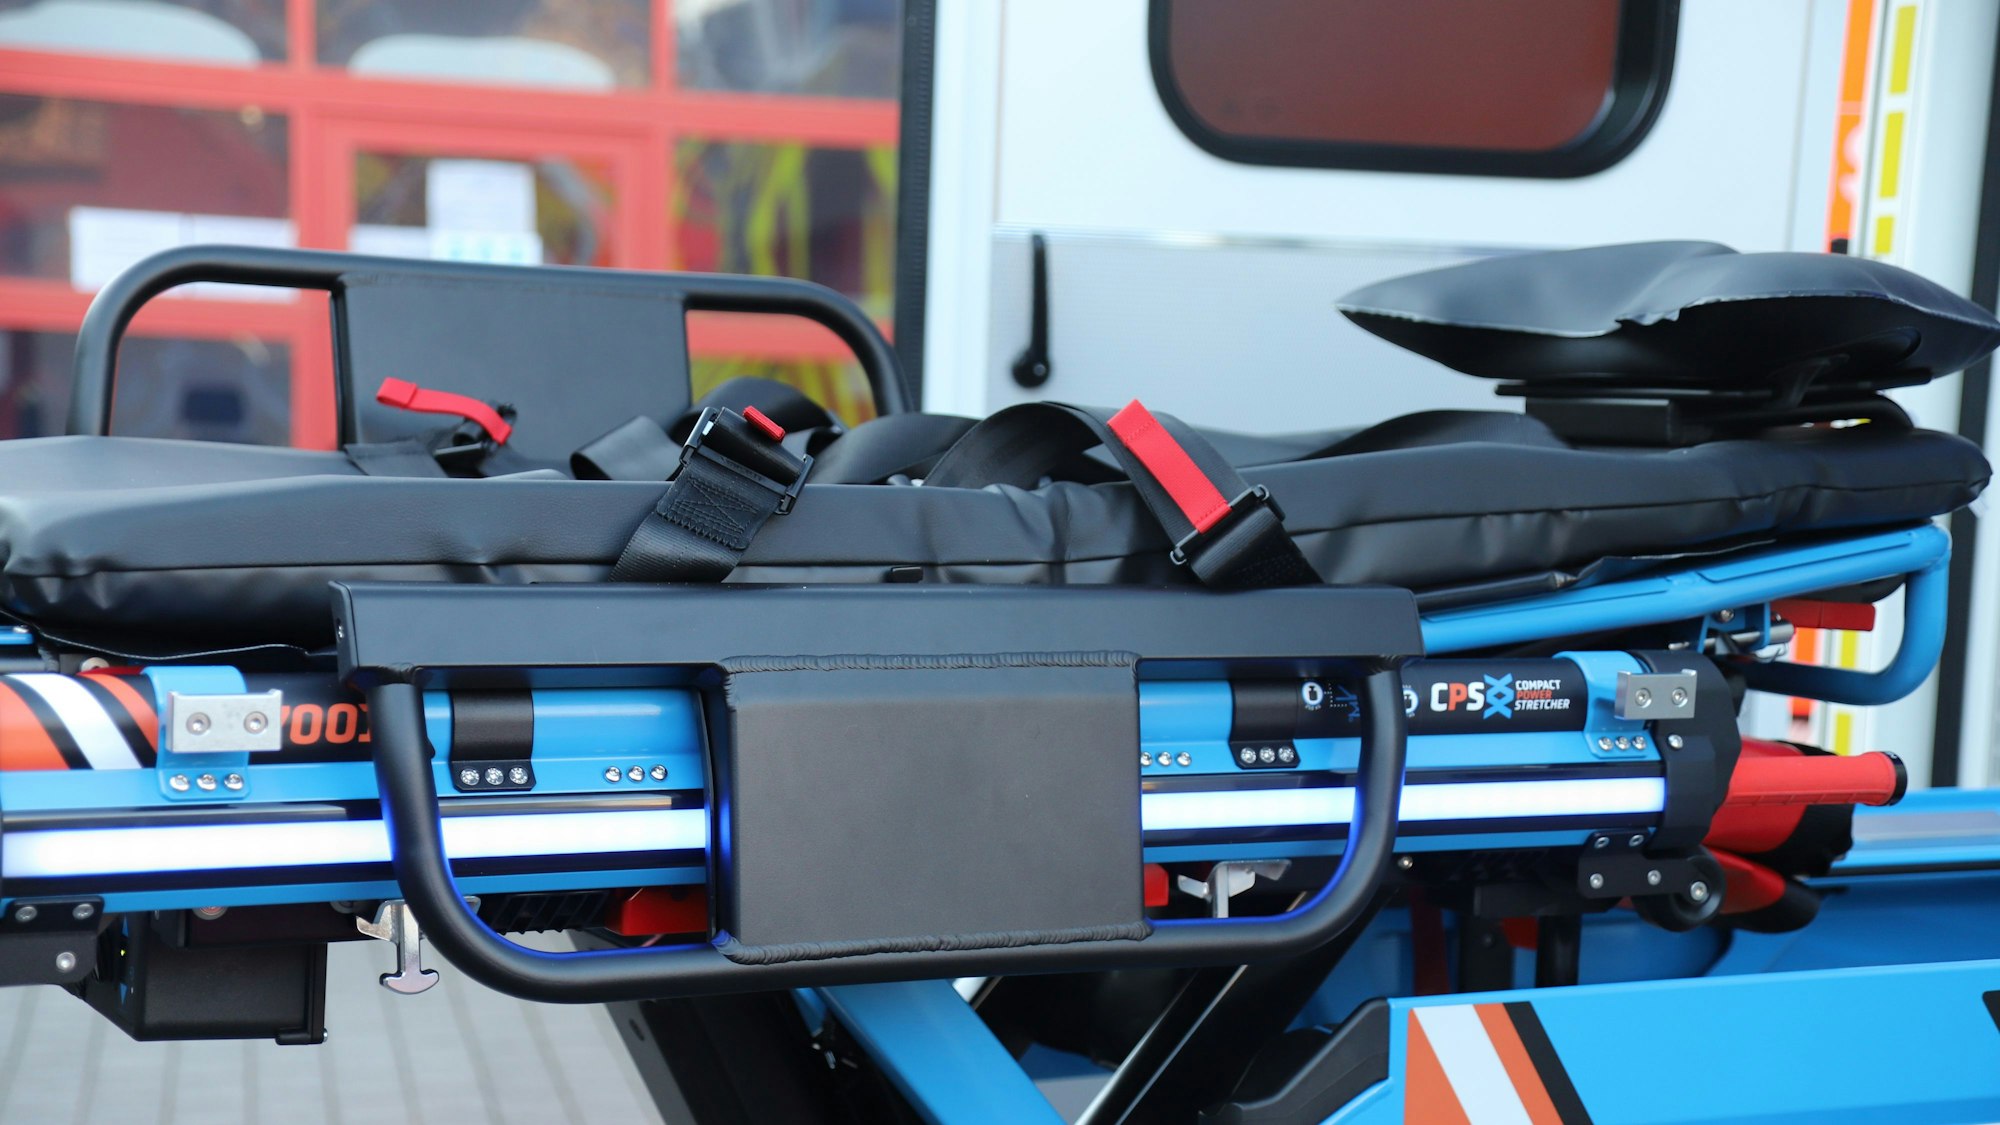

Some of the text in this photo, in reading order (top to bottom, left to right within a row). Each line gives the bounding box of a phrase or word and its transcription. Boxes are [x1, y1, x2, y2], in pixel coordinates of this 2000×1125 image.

[1515, 679, 1561, 690] COMPACT
[1516, 690, 1552, 699] POWER
[1514, 699, 1570, 711] STRETCHER
